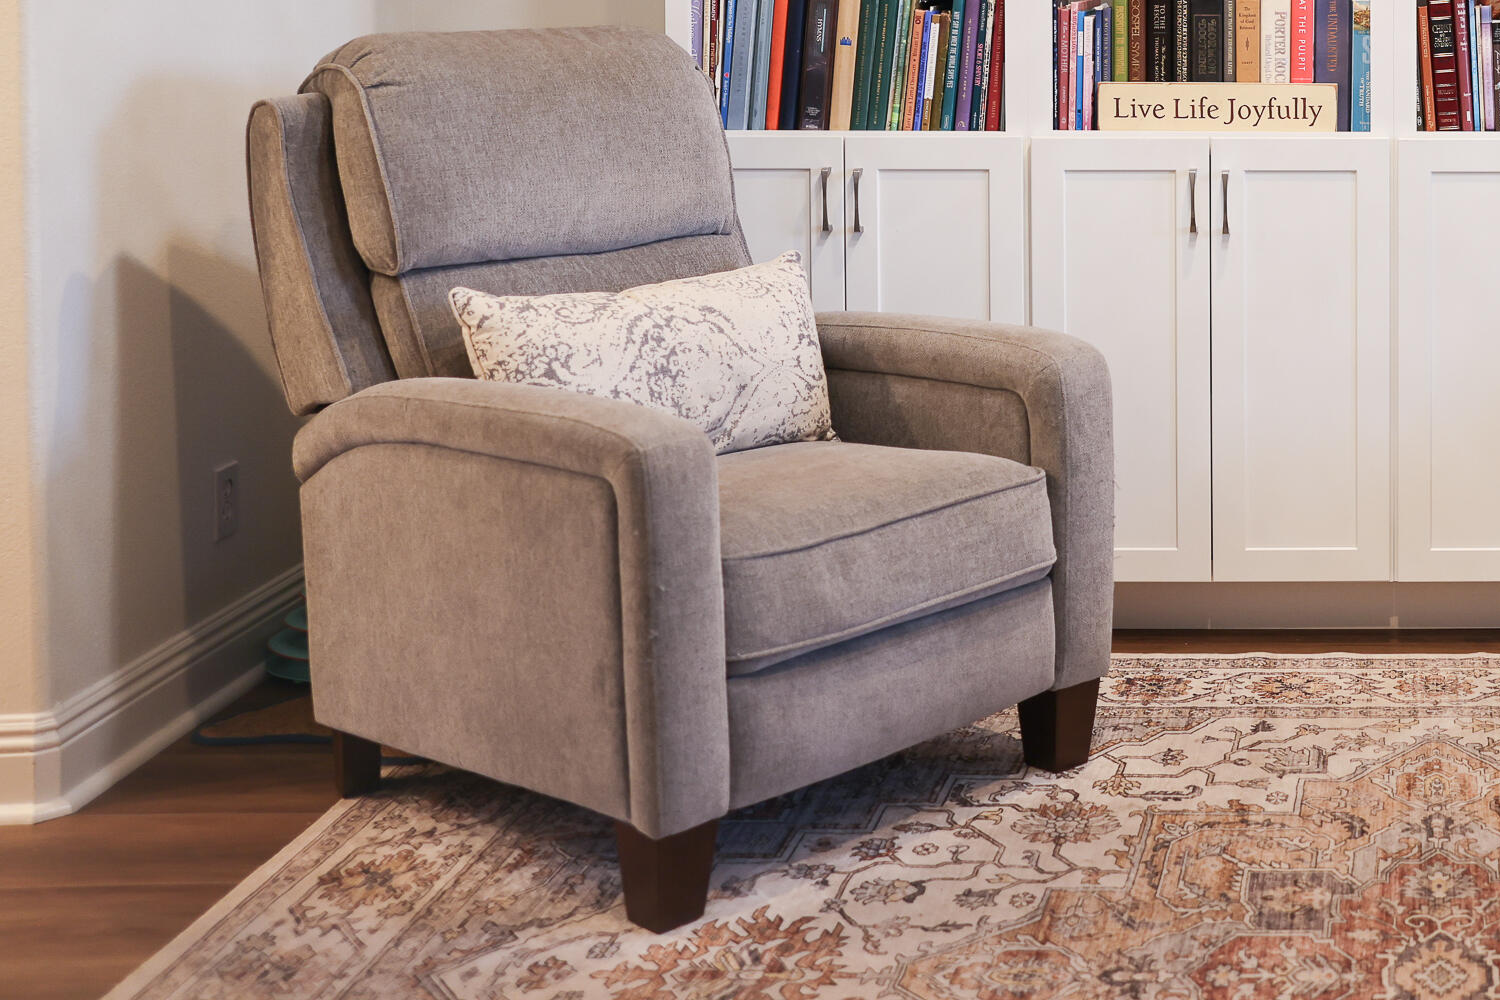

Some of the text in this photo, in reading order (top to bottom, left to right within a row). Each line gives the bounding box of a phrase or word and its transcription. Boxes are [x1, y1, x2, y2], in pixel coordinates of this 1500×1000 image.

[1160, 5, 1166, 14] TO
[1198, 19, 1206, 74] DOCTRINE
[1208, 19, 1216, 74] MORMON
[1274, 11, 1287, 55] PORTER
[1327, 13, 1337, 72] UNDAUNTED
[948, 69, 956, 79] SAYS
[949, 55, 957, 69] WORLD
[947, 80, 955, 88] YES
[1113, 96, 1322, 126] Live Life Joyfully
